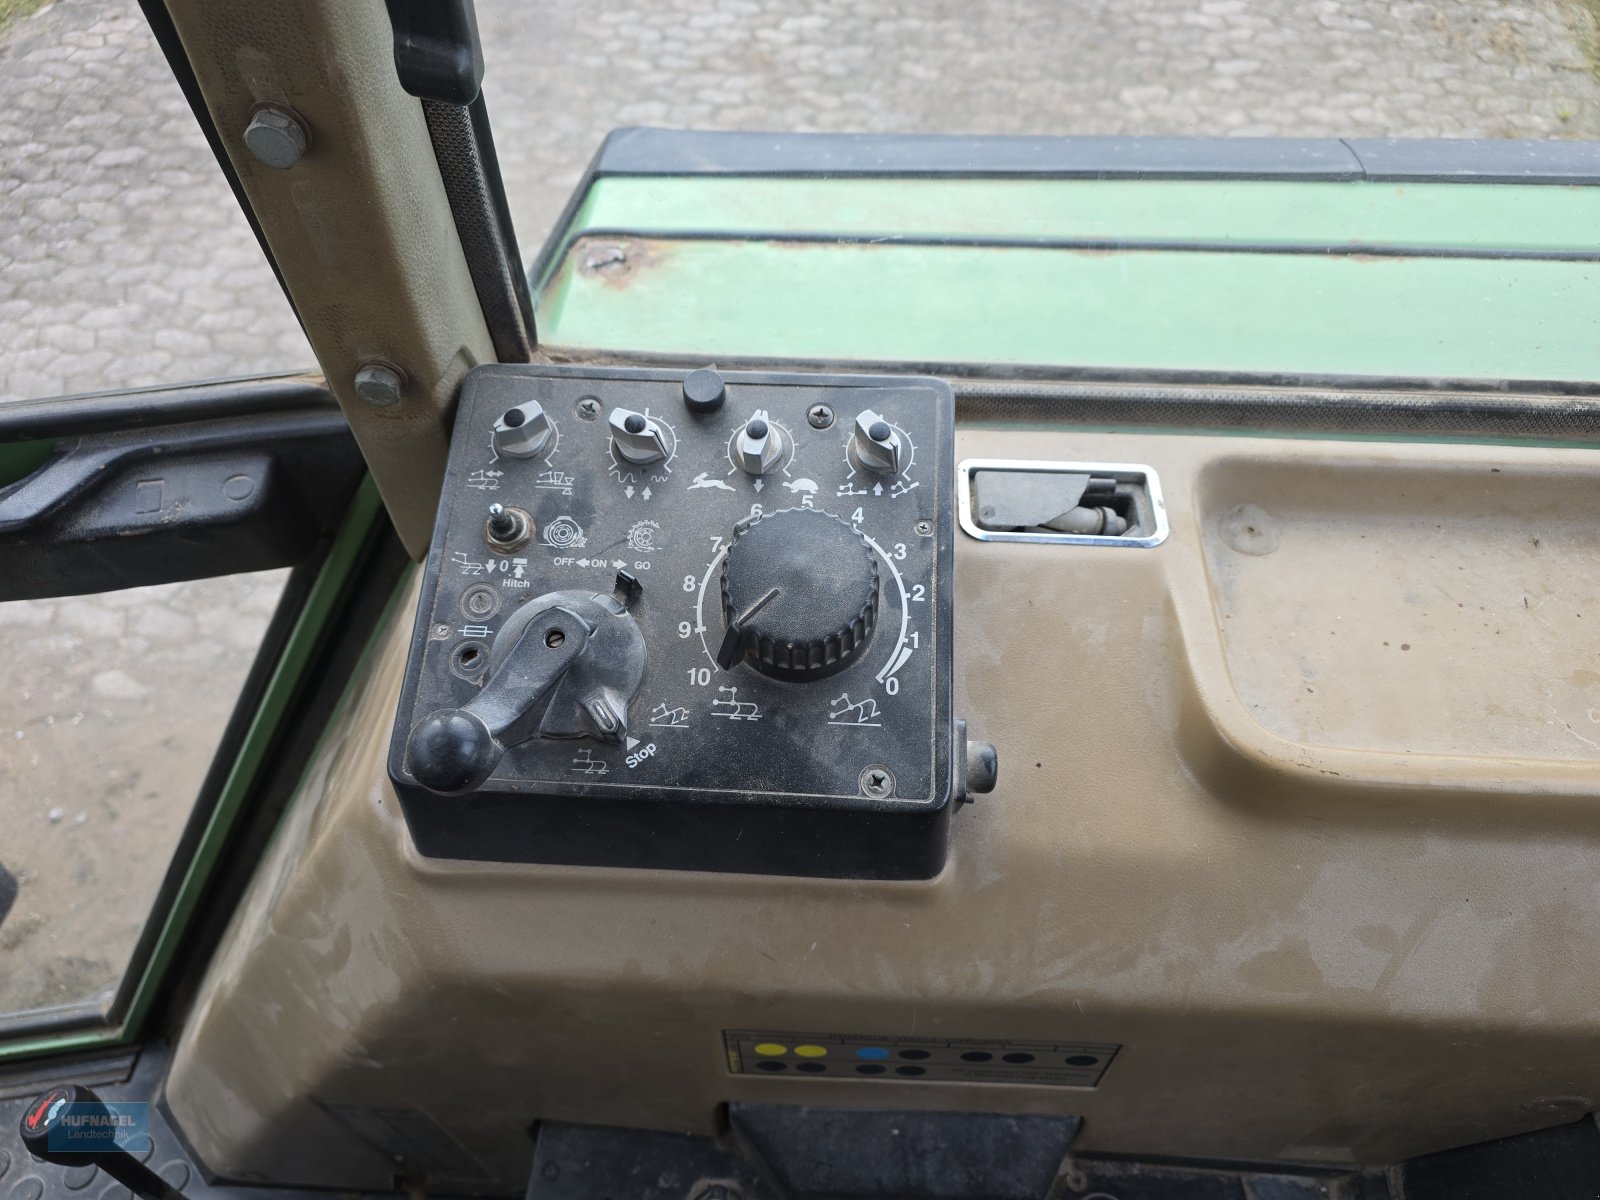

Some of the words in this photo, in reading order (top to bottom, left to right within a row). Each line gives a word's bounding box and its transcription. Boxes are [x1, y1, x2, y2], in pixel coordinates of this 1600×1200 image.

[801, 494, 814, 509] 5
[750, 503, 764, 518] 6
[852, 507, 865, 524] 4
[709, 536, 723, 553] 7
[894, 543, 907, 560] 3
[499, 560, 508, 572] 0
[554, 556, 575, 567] OFF
[591, 559, 608, 569] ON
[634, 561, 651, 570] GO
[502, 578, 531, 588] Hitch
[682, 574, 696, 592] 8
[912, 584, 926, 602] 2
[678, 621, 692, 639] 9
[910, 631, 920, 649] 1
[687, 667, 711, 687] 10
[885, 676, 899, 696] 0
[625, 743, 657, 769] Stop
